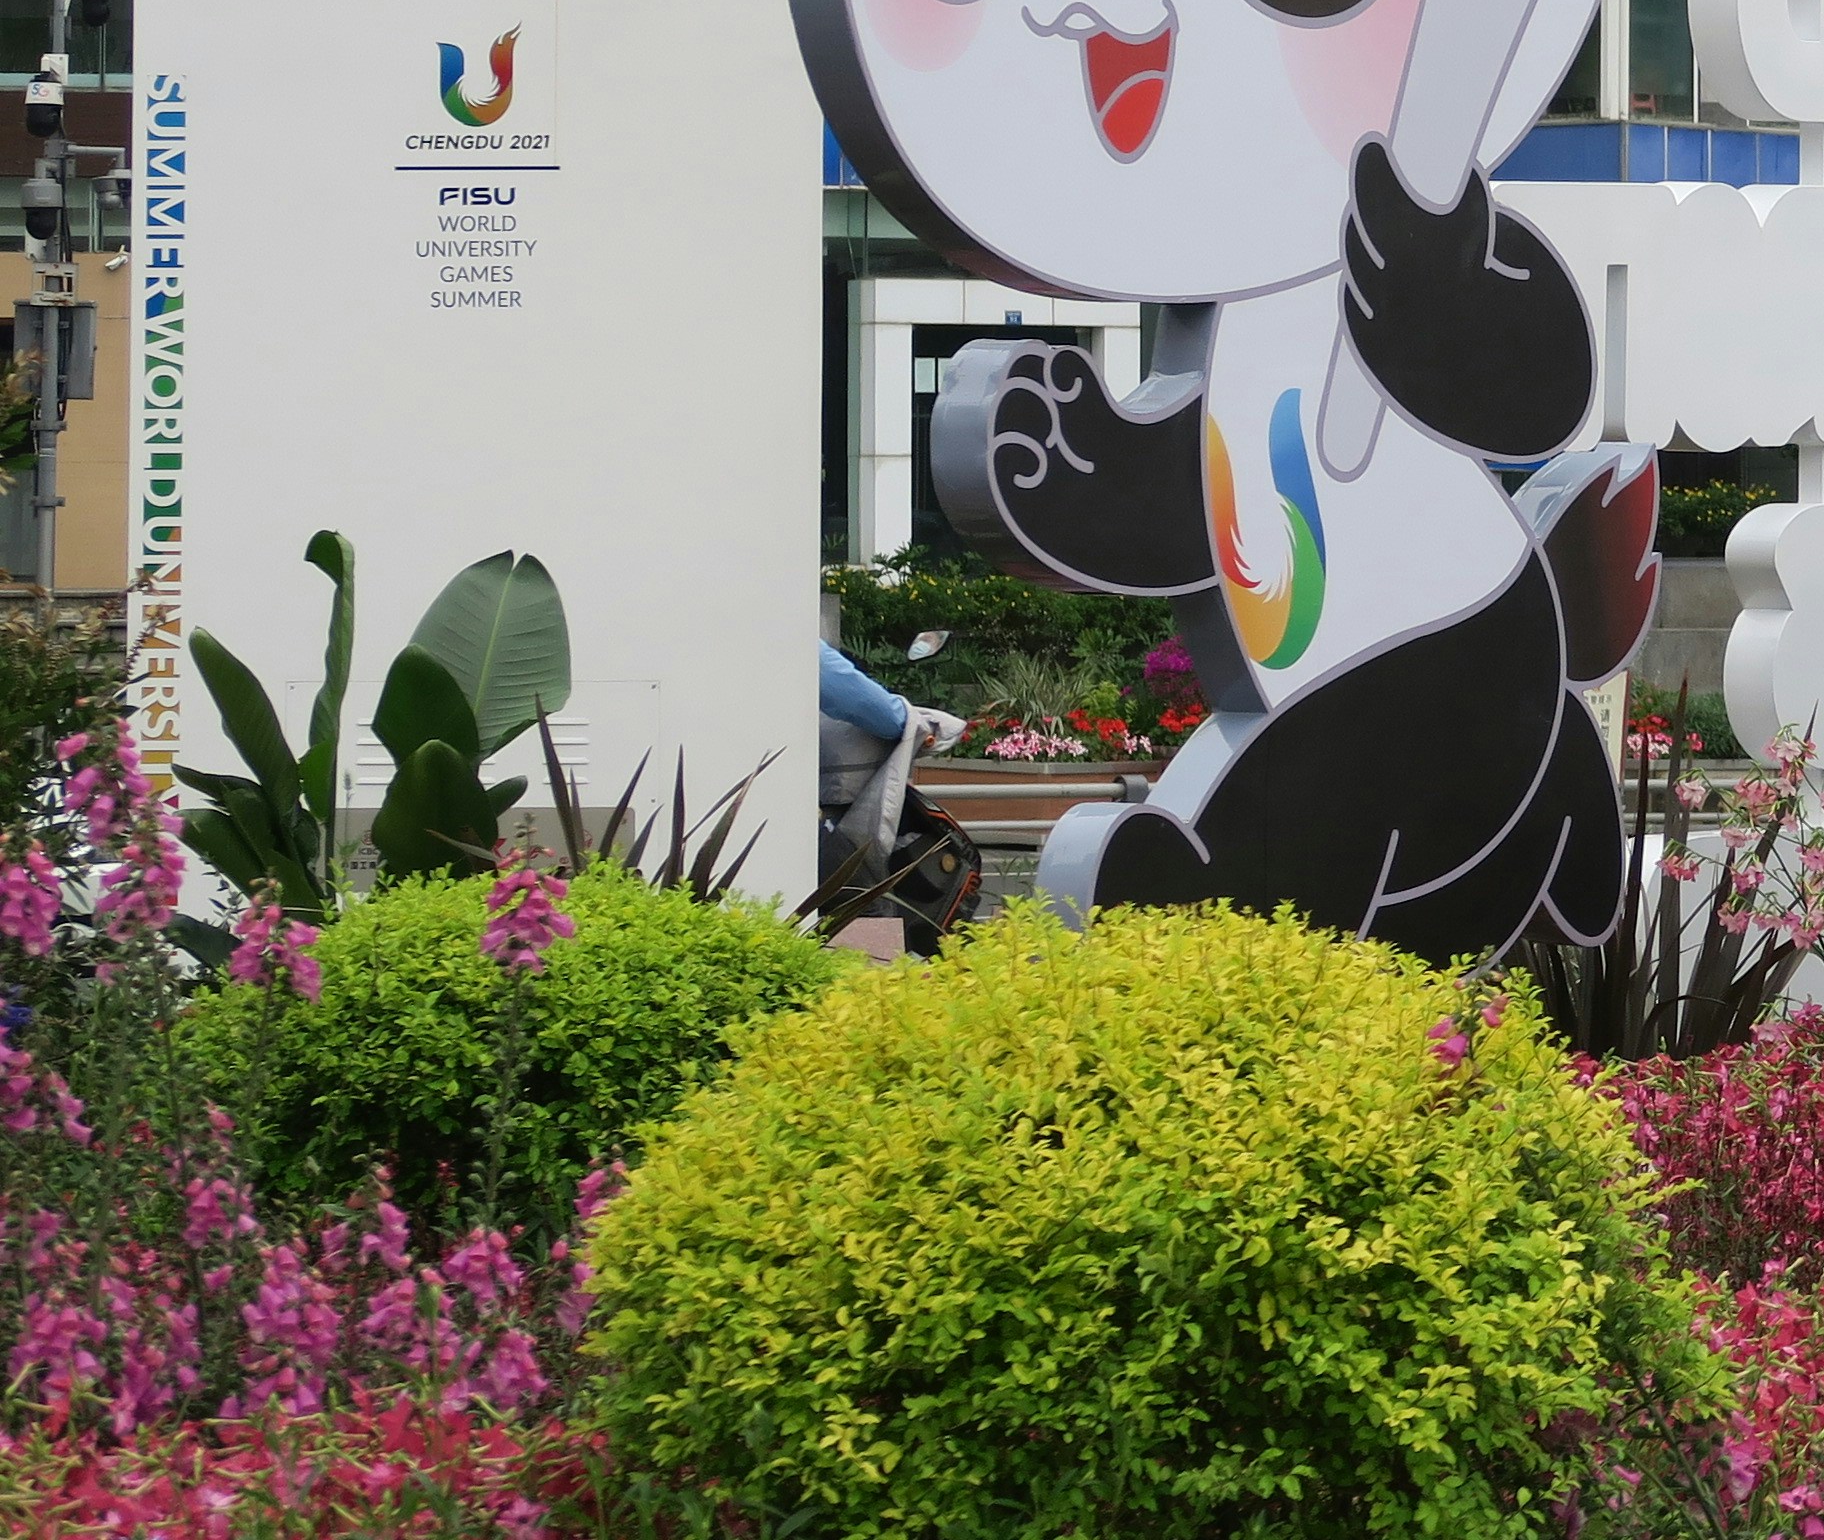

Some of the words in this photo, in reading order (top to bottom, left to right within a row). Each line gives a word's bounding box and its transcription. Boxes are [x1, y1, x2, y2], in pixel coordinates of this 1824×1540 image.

[405, 134, 503, 150] CHENGDU
[509, 134, 551, 150] 2021
[439, 186, 516, 206] FISU
[437, 215, 517, 232] WORLD
[415, 240, 538, 258] UNIVERSITY
[439, 265, 514, 283] GAMES
[430, 290, 523, 309] SUMMER
